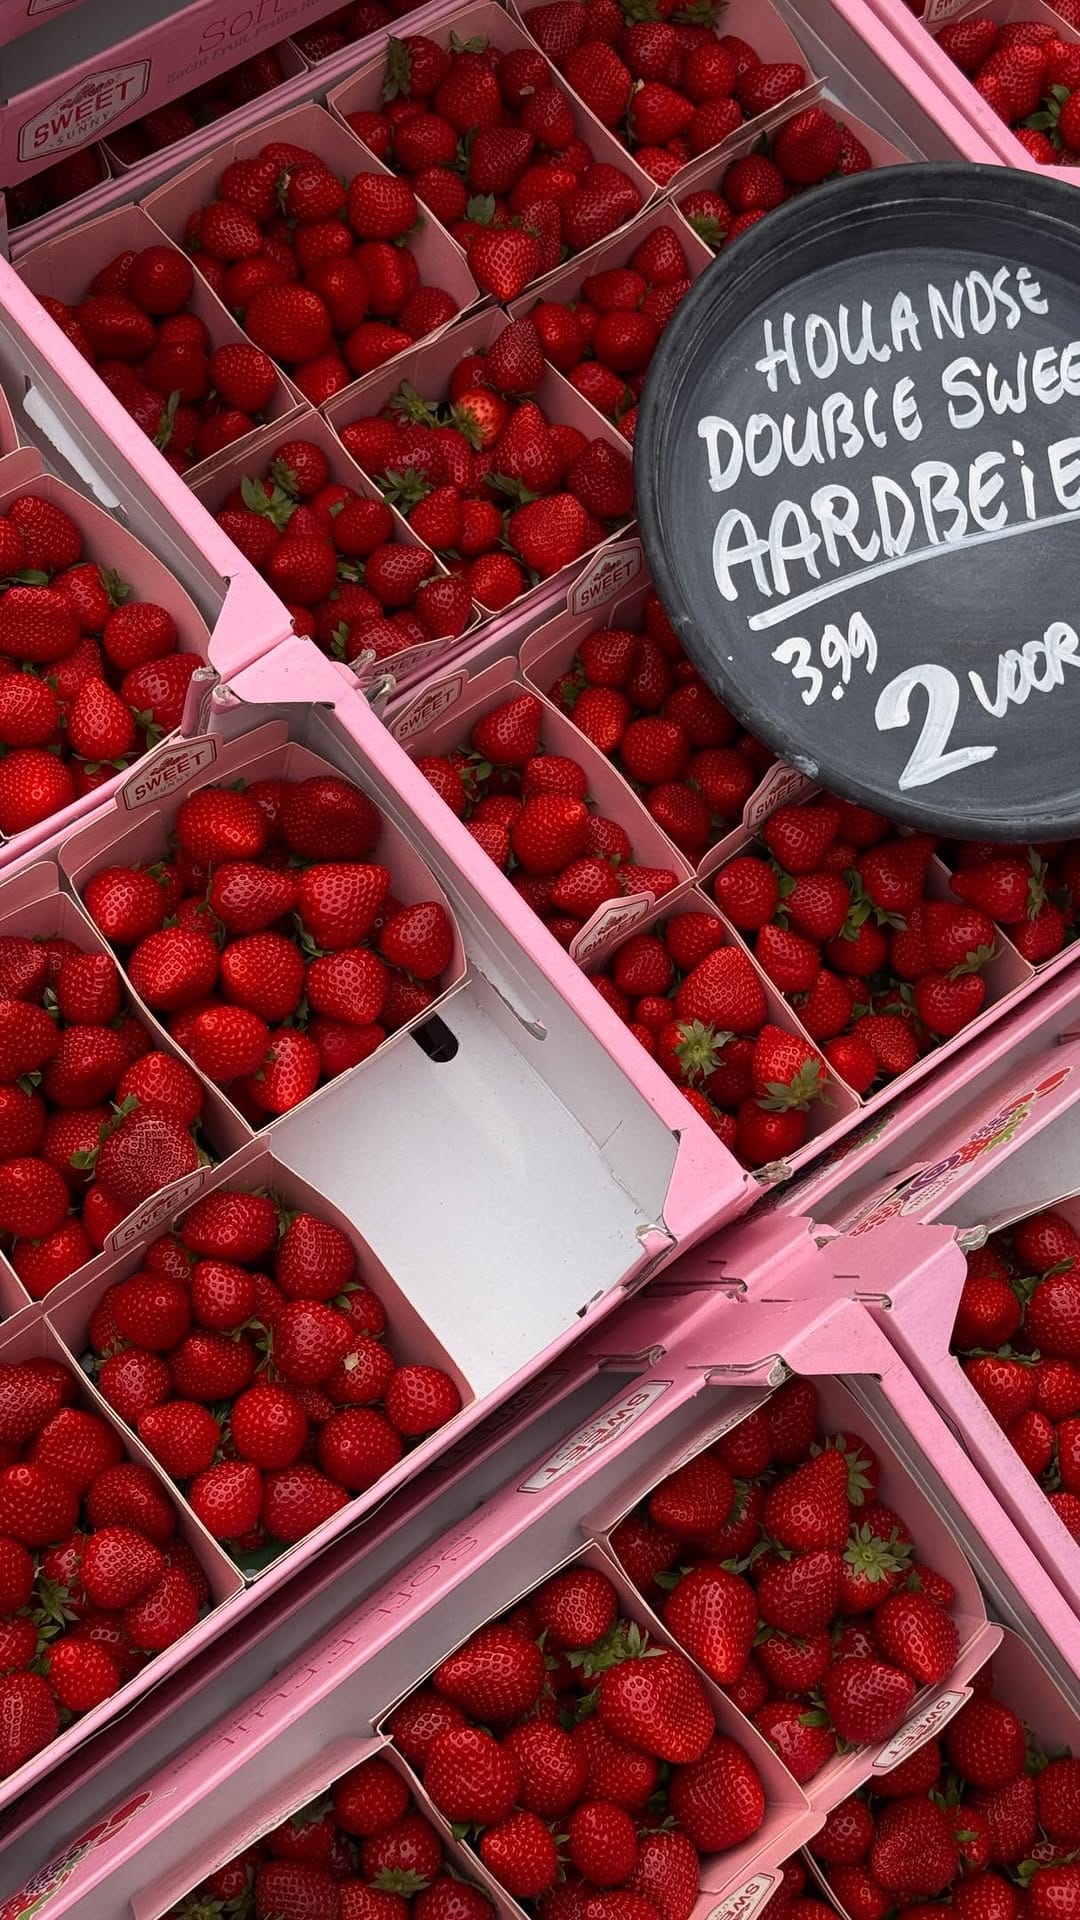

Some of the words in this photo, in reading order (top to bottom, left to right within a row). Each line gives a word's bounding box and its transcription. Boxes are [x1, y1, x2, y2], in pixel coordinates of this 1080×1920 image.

[34, 76, 136, 148] SWEET
[56, 112, 112, 146] SUNNY
[755, 266, 1049, 393] HOLLANDSE
[698, 376, 923, 492] DOUBLE
[581, 560, 634, 606] SWEET
[400, 688, 454, 736] SWEET
[875, 664, 998, 791] 2
[135, 750, 205, 801] SWEET
[124, 1183, 194, 1241] SWEET
[544, 1393, 651, 1481] SWEET
[889, 1699, 951, 1759] SWEET
